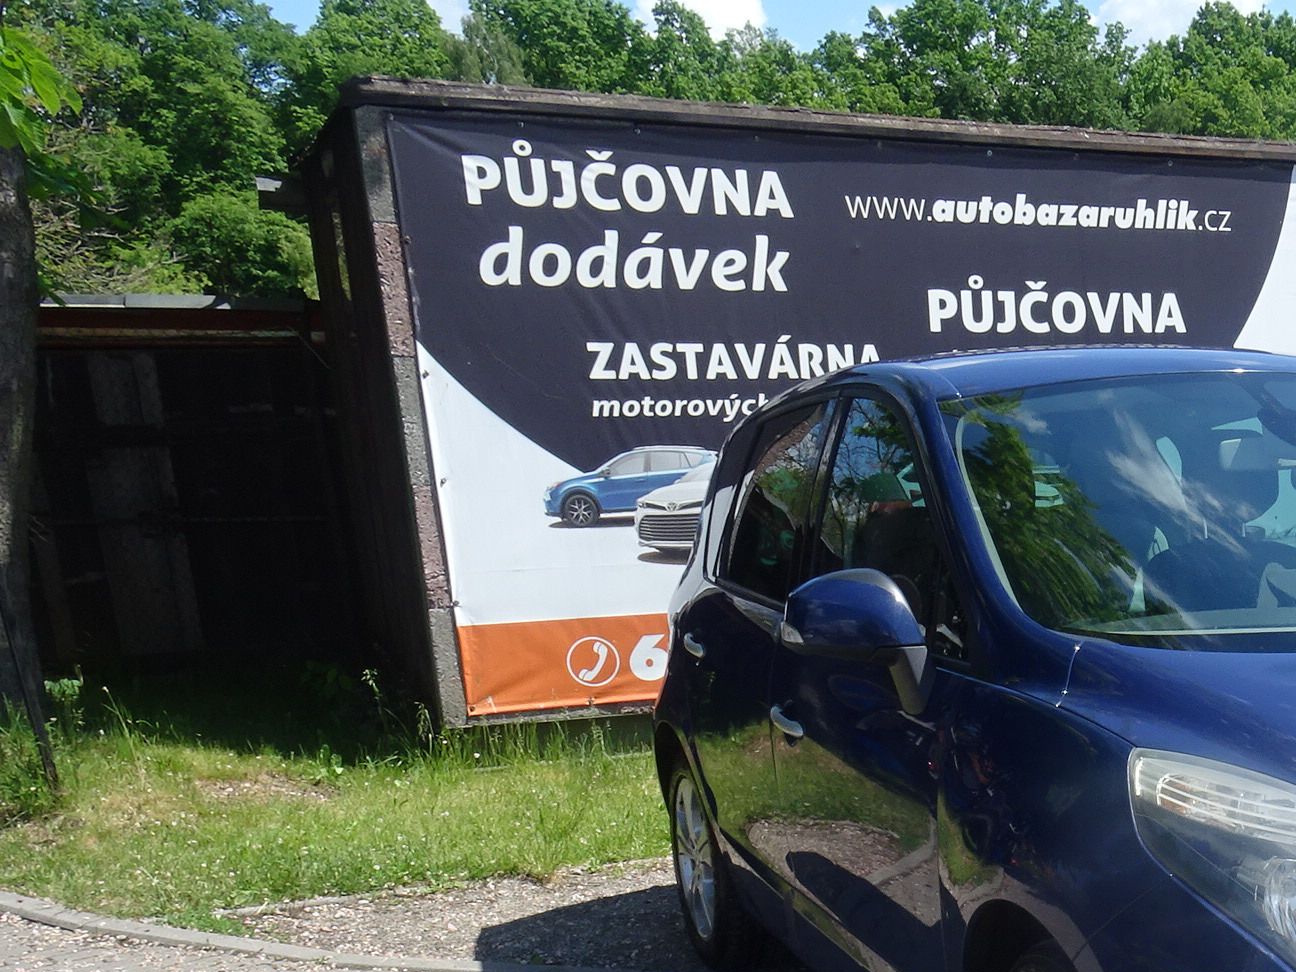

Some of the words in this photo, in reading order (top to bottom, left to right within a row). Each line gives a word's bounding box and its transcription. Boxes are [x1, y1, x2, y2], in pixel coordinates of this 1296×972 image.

[461, 139, 795, 218] PŮJČOVNA
[844, 194, 1232, 232] www.autobazaruhlik.cz
[479, 226, 790, 292] dodávek
[927, 275, 1187, 333] PŮJČOVNA
